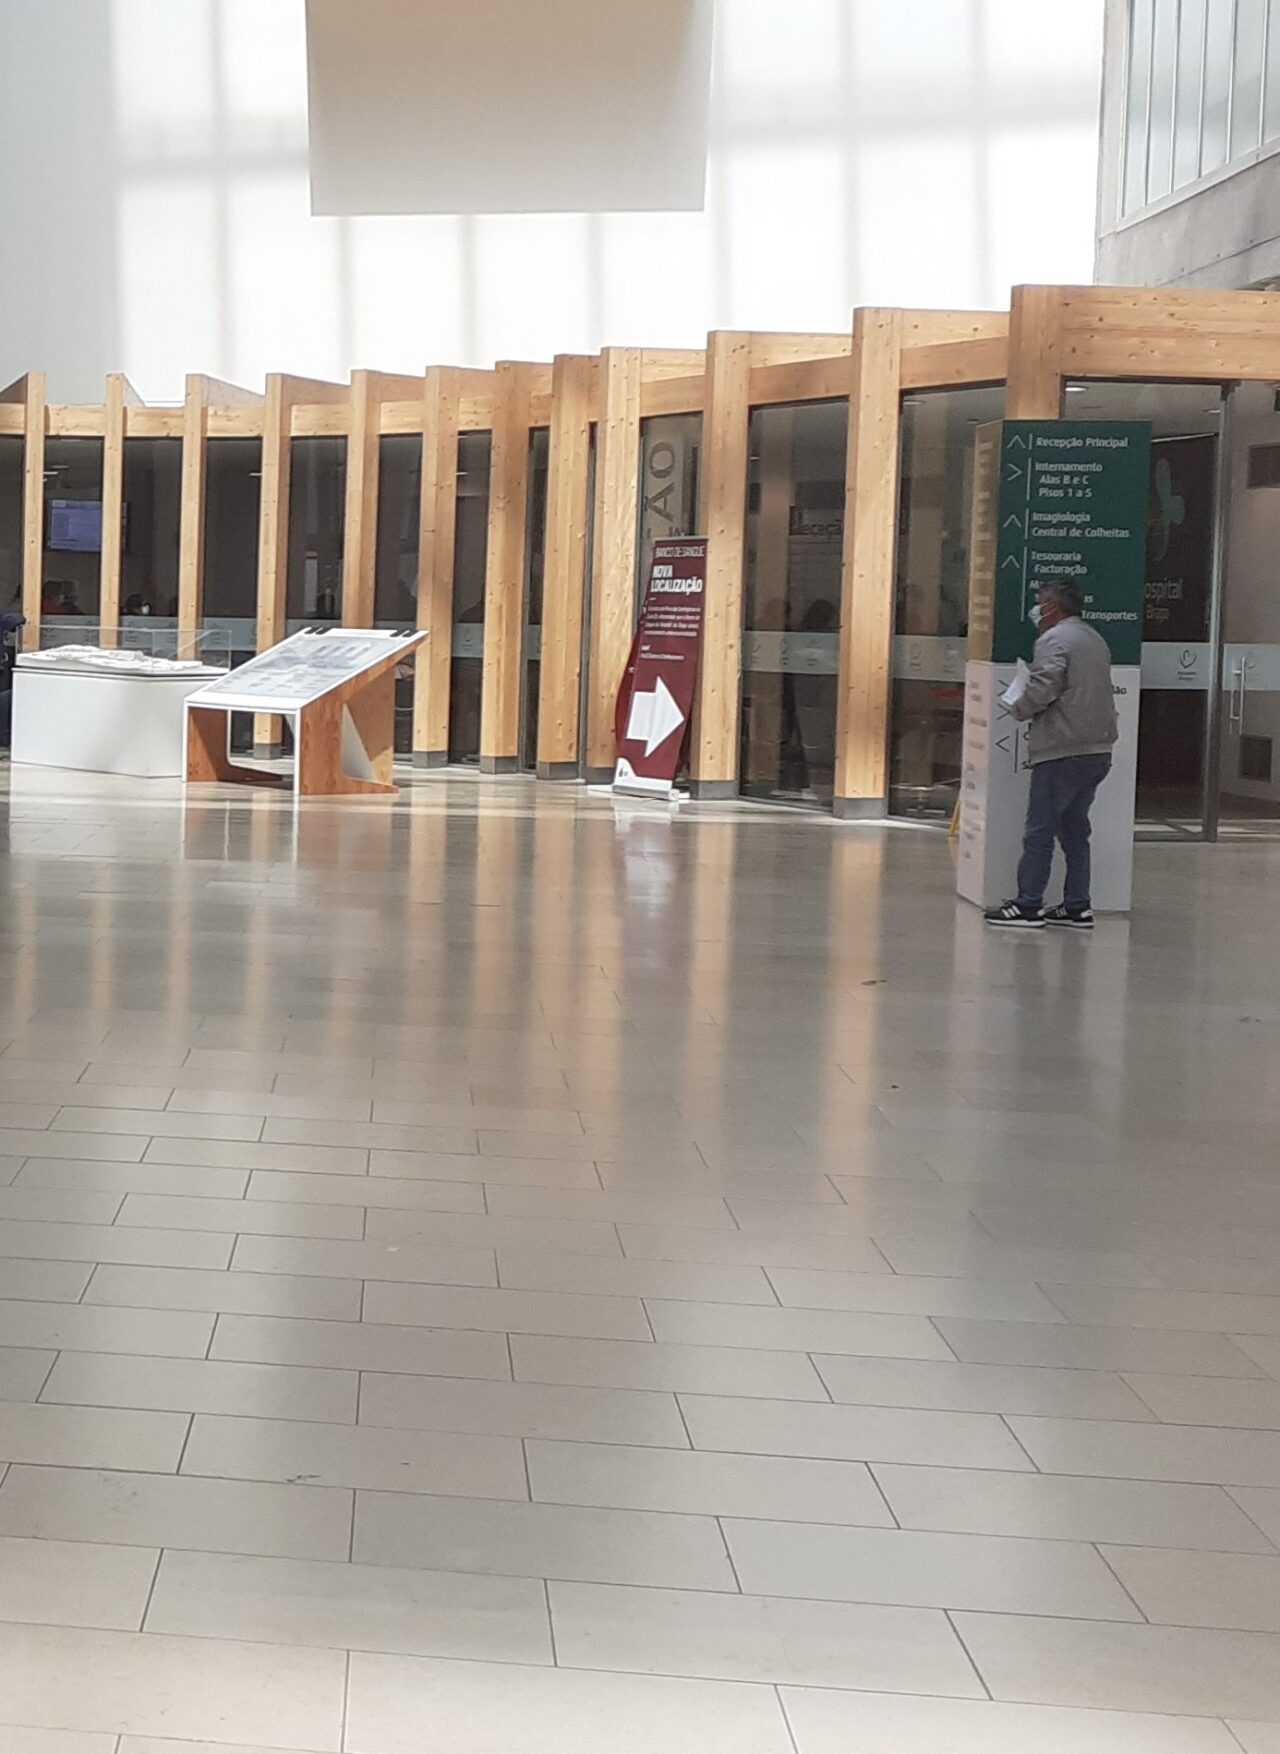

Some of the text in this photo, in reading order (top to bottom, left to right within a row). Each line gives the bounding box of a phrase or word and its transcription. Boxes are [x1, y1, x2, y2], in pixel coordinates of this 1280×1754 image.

[1036, 437, 1128, 449] Recepção Principal
[1035, 462, 1103, 472] Internamento
[1039, 475, 1090, 484] Alas B e C
[1038, 487, 1065, 497] Pisos
[1067, 488, 1073, 497] 1
[1075, 489, 1083, 497] a
[1032, 511, 1091, 523] Imagiologia
[1032, 526, 1130, 538] Central de Colheitas
[1031, 551, 1082, 561] Tesouraria
[652, 565, 673, 578] NOVA
[1034, 564, 1088, 576] Facturação
[650, 576, 703, 596] LOCALIZAÇÃO
[1144, 577, 1183, 603] ospital
[1081, 609, 1138, 622] Transportes
